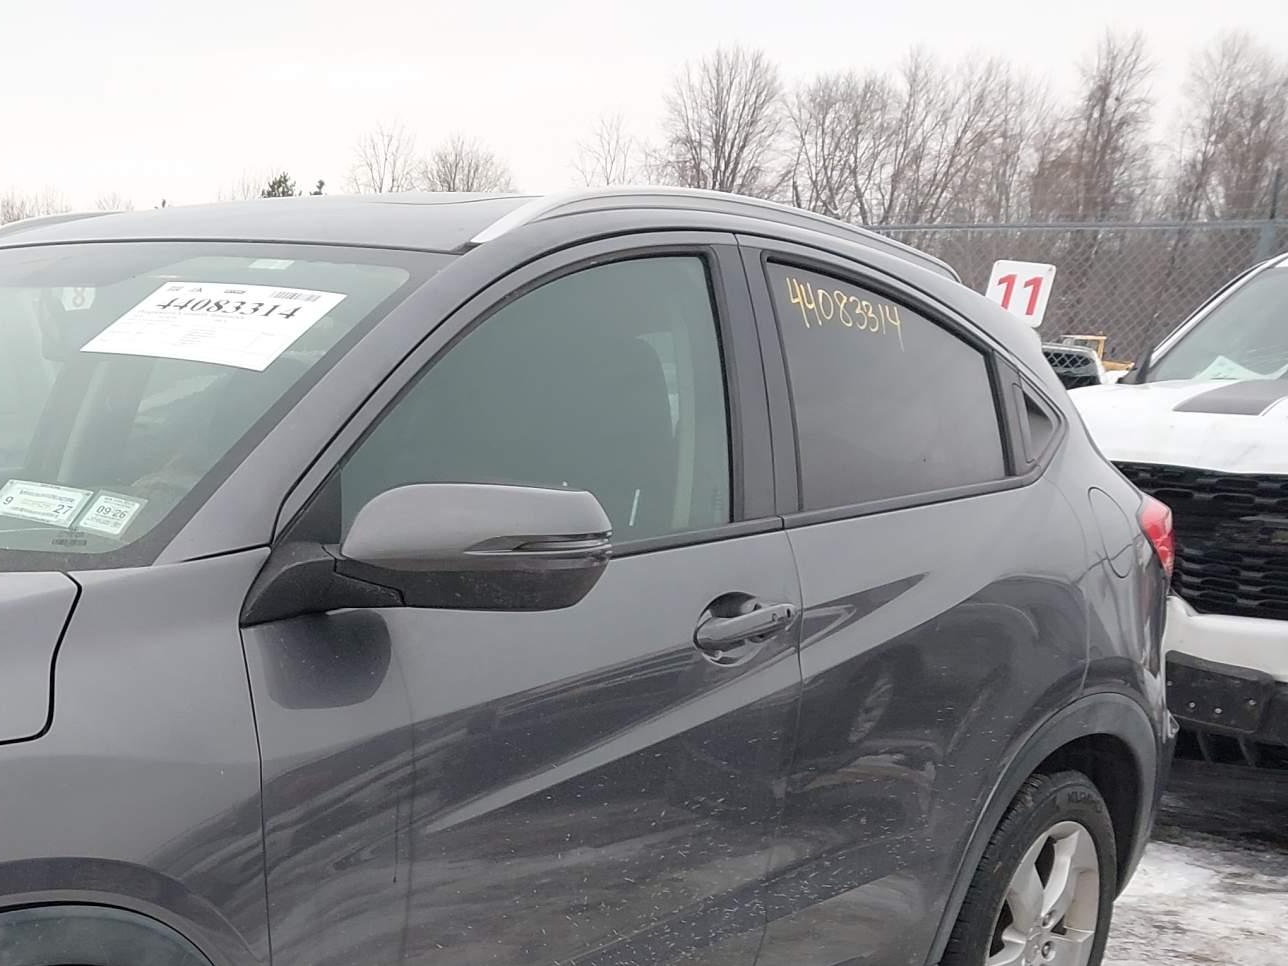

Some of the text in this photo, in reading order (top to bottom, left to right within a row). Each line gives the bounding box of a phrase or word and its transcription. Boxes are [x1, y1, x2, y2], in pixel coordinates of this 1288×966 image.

[997, 274, 1043, 315] 11
[156, 297, 303, 320] 44083314
[785, 277, 905, 352] 44083314
[2, 496, 14, 506] 9
[53, 504, 73, 515] 27
